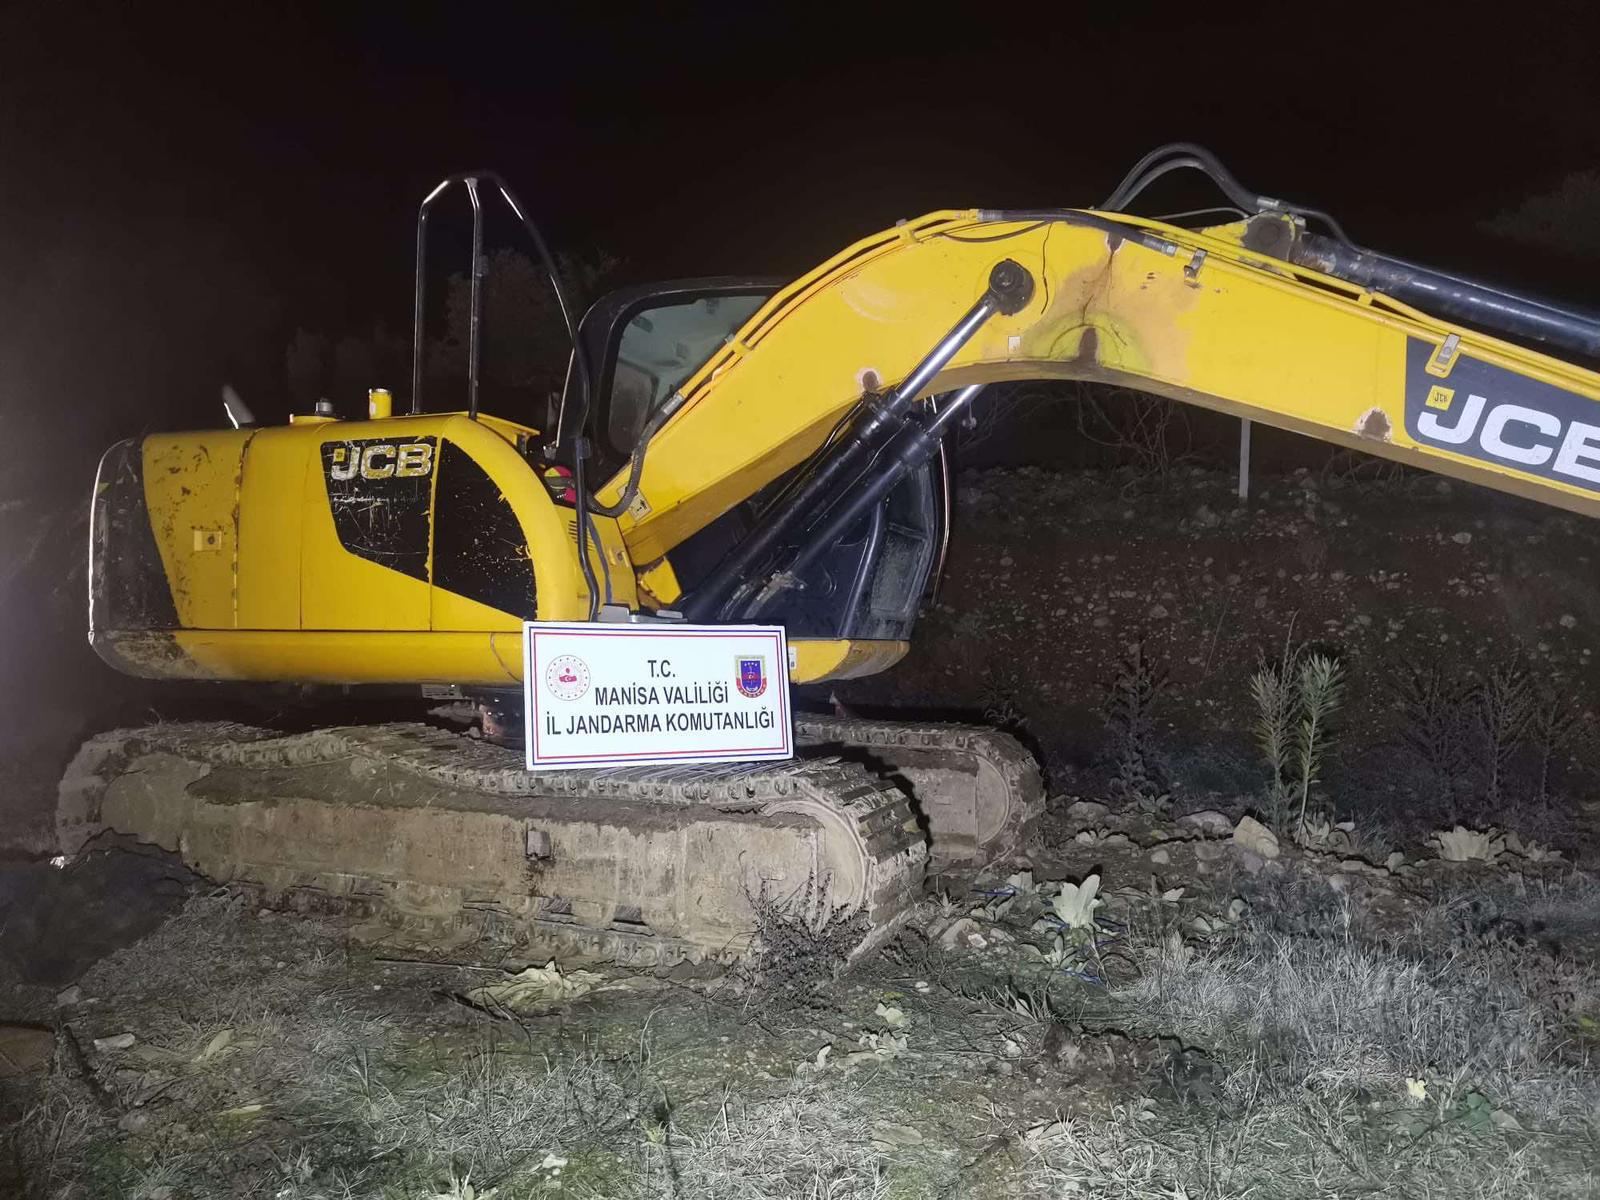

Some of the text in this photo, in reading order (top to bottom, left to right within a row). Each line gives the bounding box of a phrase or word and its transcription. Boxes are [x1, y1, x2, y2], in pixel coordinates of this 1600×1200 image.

[331, 443, 433, 480] JCB
[647, 659, 676, 678] T.C.
[595, 682, 660, 706] MANİSA
[663, 680, 729, 704] VALİLİĞİ
[546, 706, 775, 735] İL JANDARMA KOMUTANLIĞI
